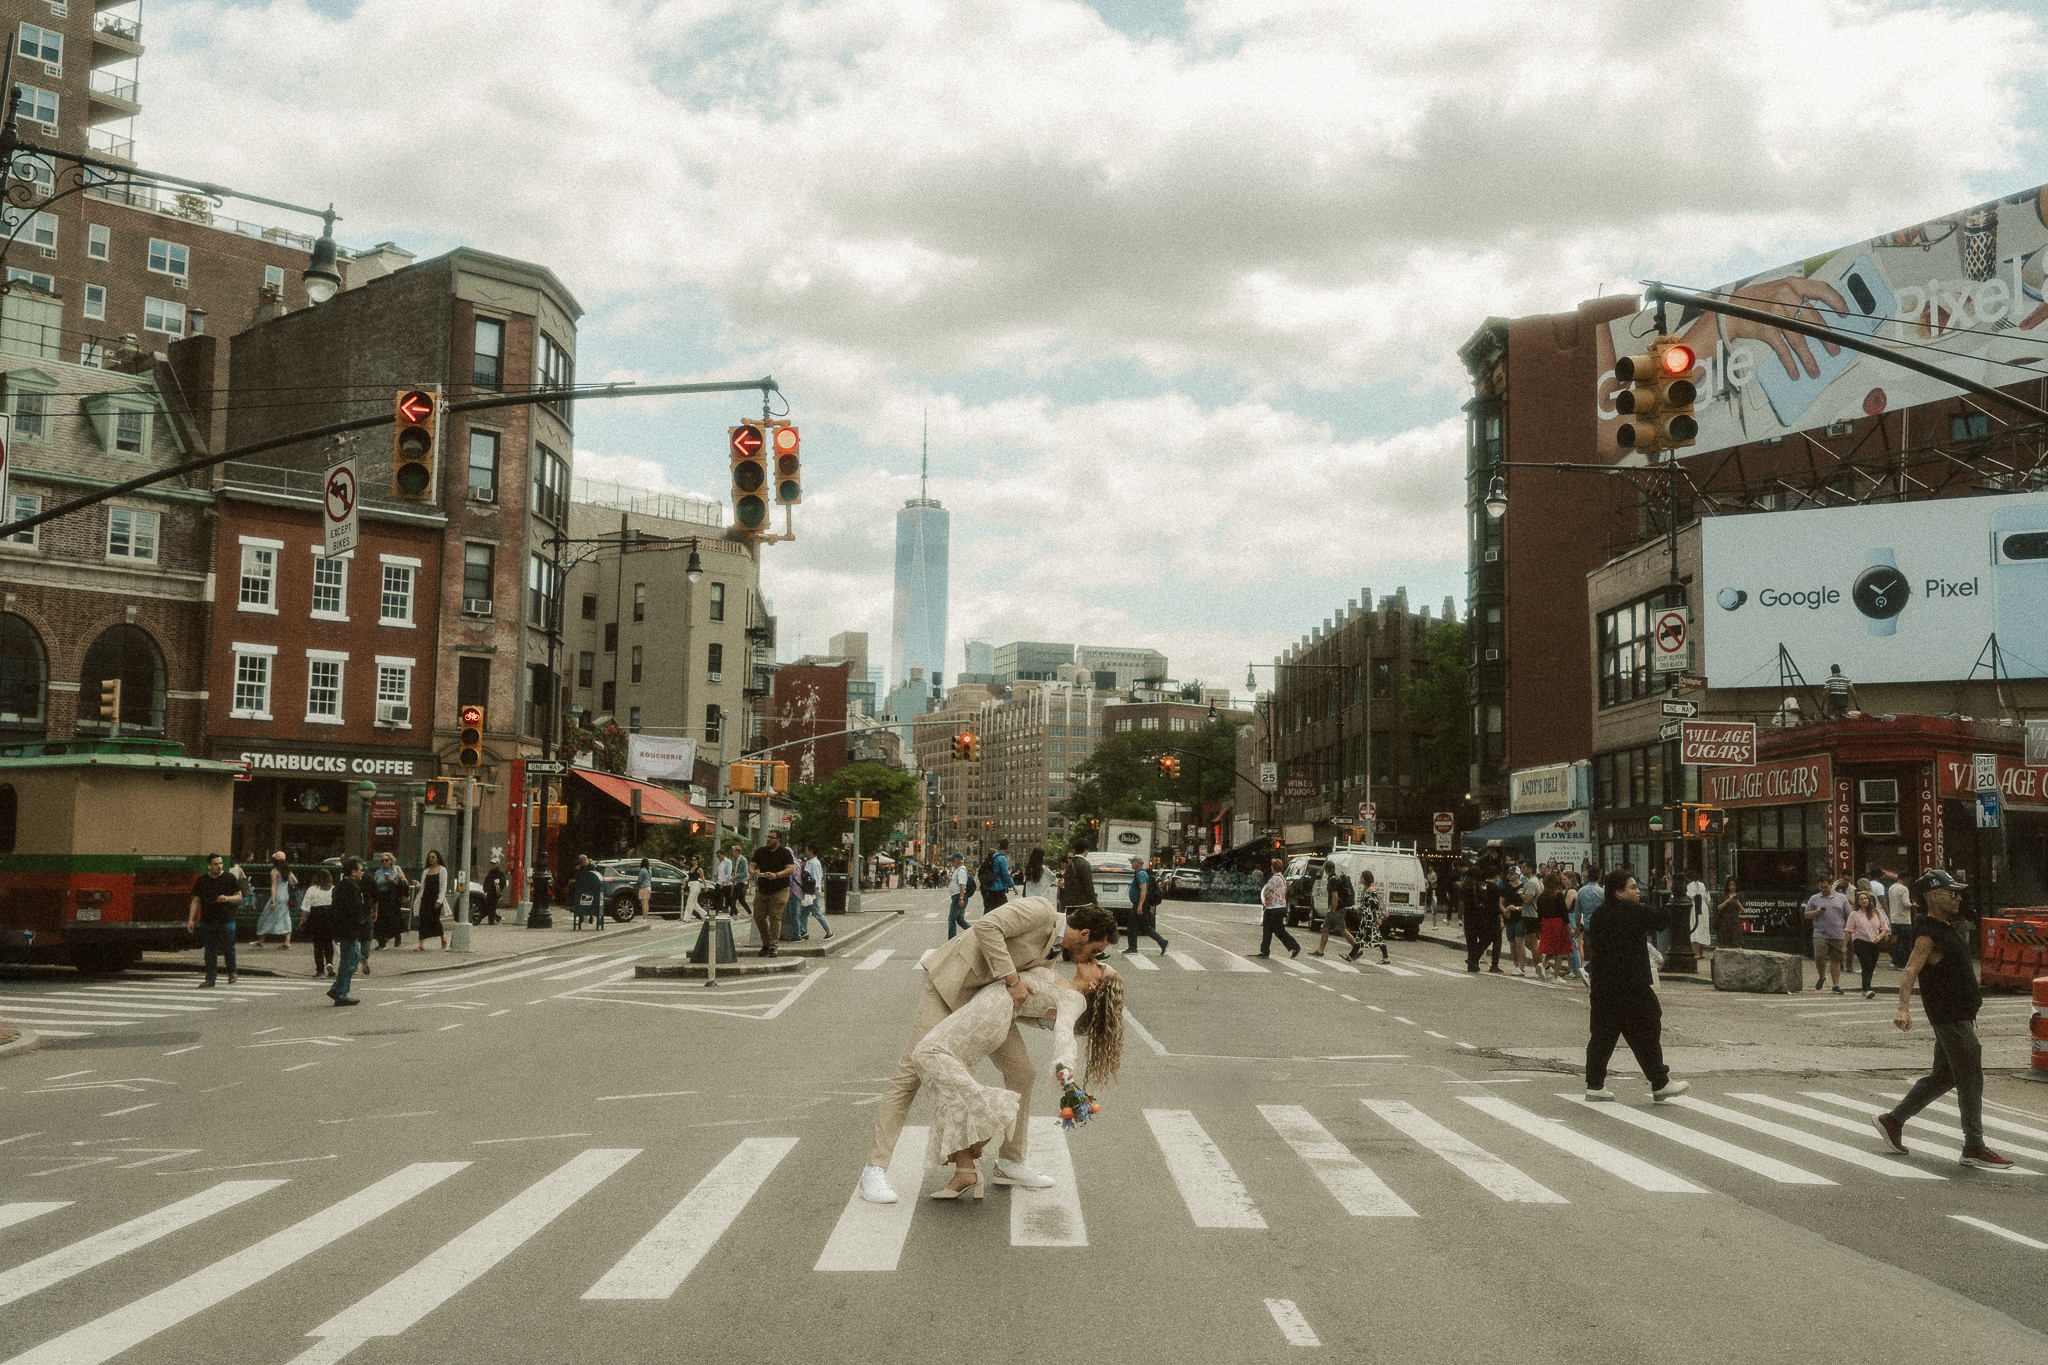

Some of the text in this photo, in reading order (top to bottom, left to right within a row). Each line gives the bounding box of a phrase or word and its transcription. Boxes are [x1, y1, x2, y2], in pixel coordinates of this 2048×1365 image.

[1597, 339, 1753, 421] Ggle
[331, 522, 351, 539] EXCEPT
[333, 537, 350, 551] BIKES
[1759, 577, 1979, 610] Google Pixel
[1666, 704, 1677, 712] ONE
[1686, 729, 1751, 744] VILLAGE
[640, 752, 682, 760] BOUCHERIE
[1686, 743, 1751, 762] CIGARS
[240, 752, 347, 773] STARBUCKS
[351, 758, 413, 776] COFFEE
[1976, 758, 1995, 766] SPEED
[1262, 774, 1276, 783] 25
[1288, 780, 1313, 788] WINES
[1711, 765, 1819, 801] VILLAGE CIGARS
[1949, 763, 2037, 797] VIAGE
[1978, 774, 1995, 788] 20
[1285, 787, 1317, 796] LIQUORS
[1521, 776, 1558, 796] ANDY'S DELI
[1540, 832, 1585, 840] FLOWERS
[1742, 922, 1747, 930] 1
